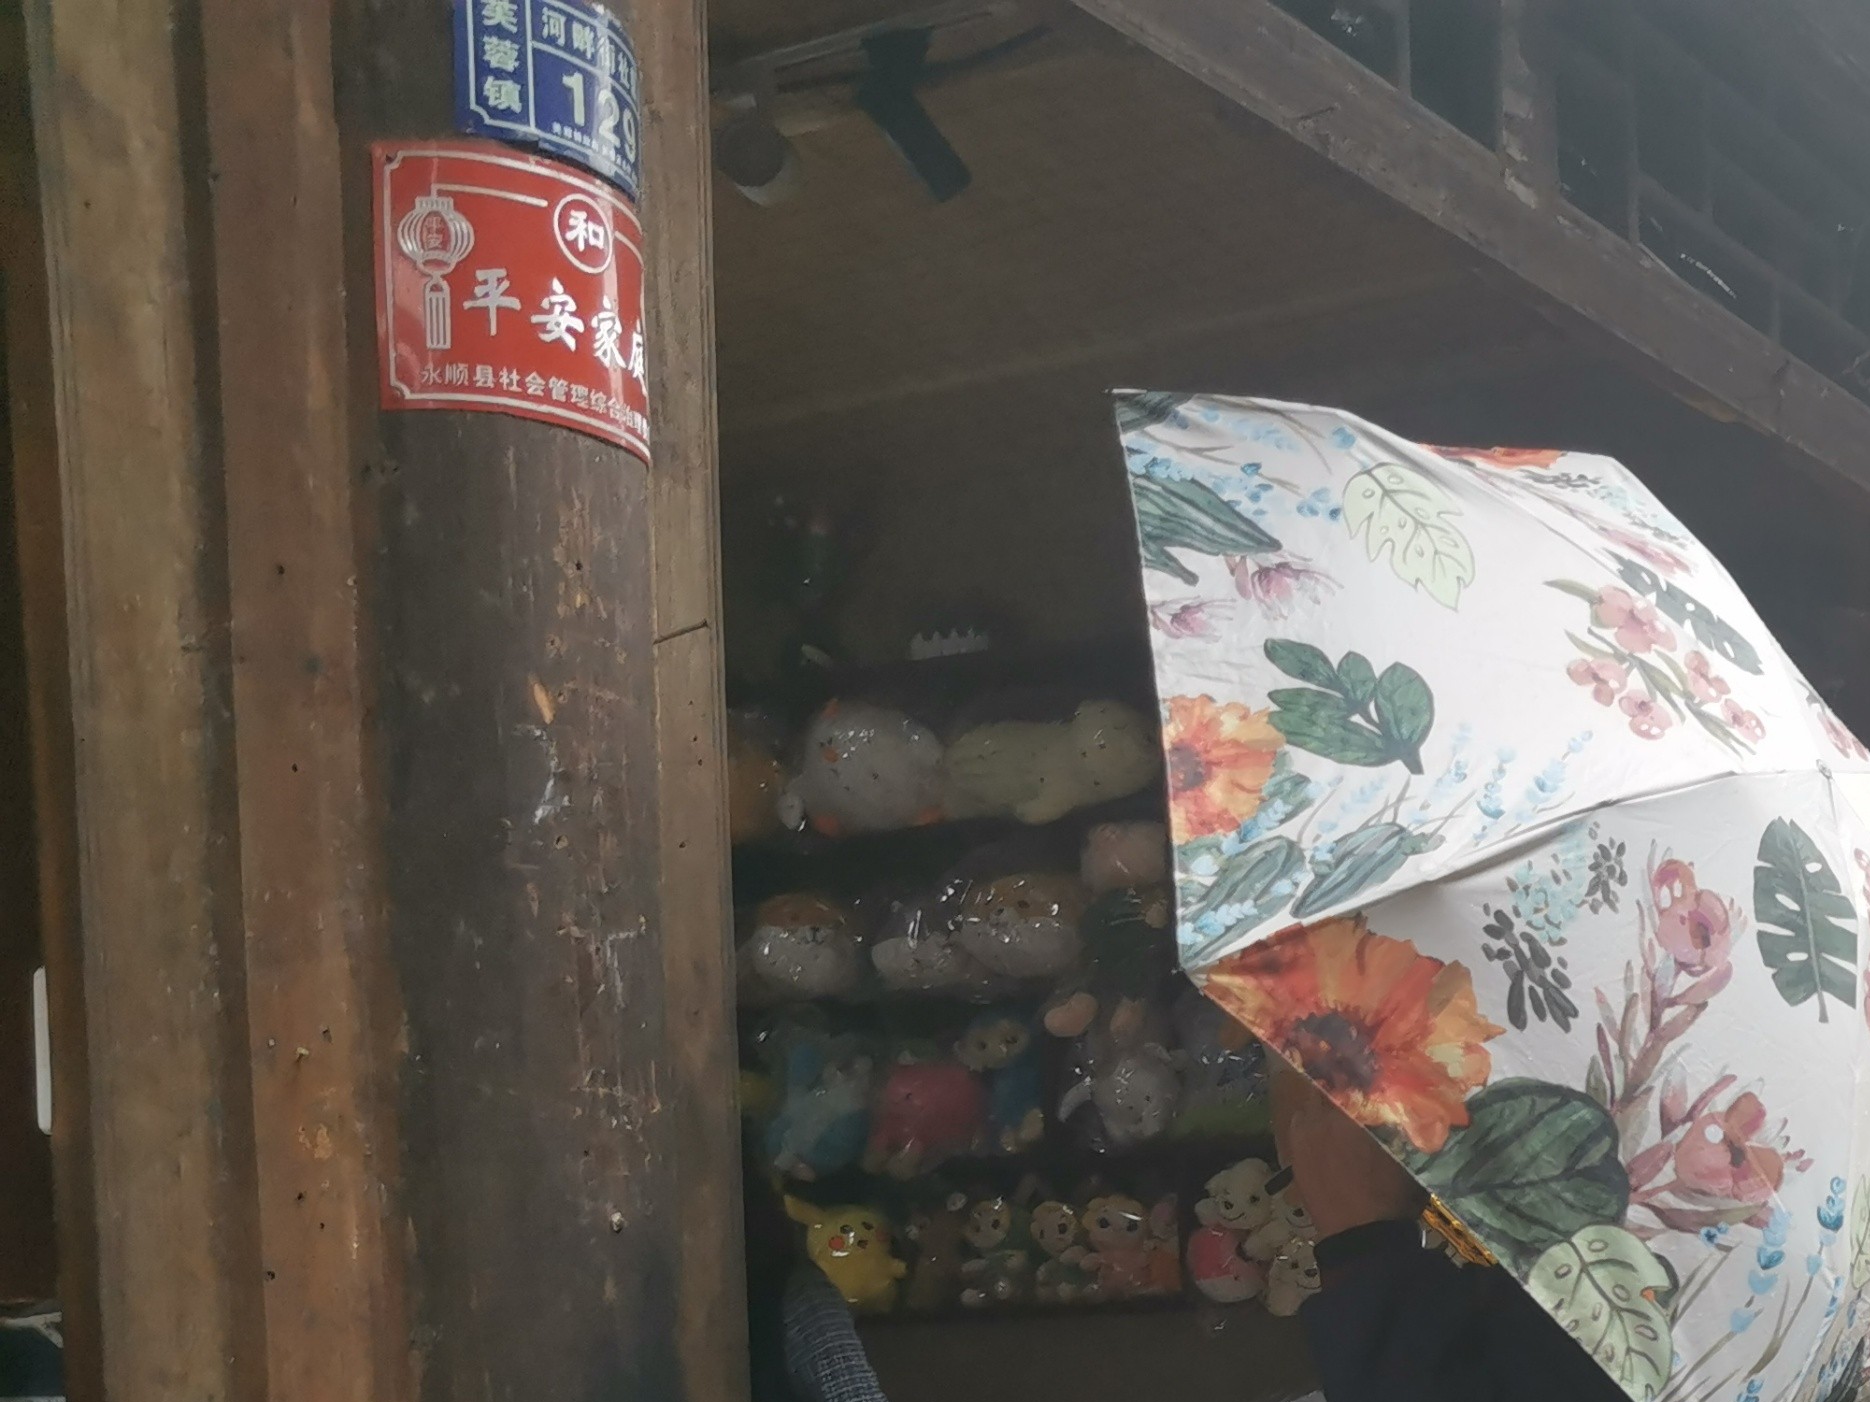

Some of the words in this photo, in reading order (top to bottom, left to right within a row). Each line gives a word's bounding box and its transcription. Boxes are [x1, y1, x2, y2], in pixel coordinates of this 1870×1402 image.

[481, 0, 522, 114] 芙蓉镇
[562, 72, 636, 163] 129
[565, 209, 606, 252] 和
